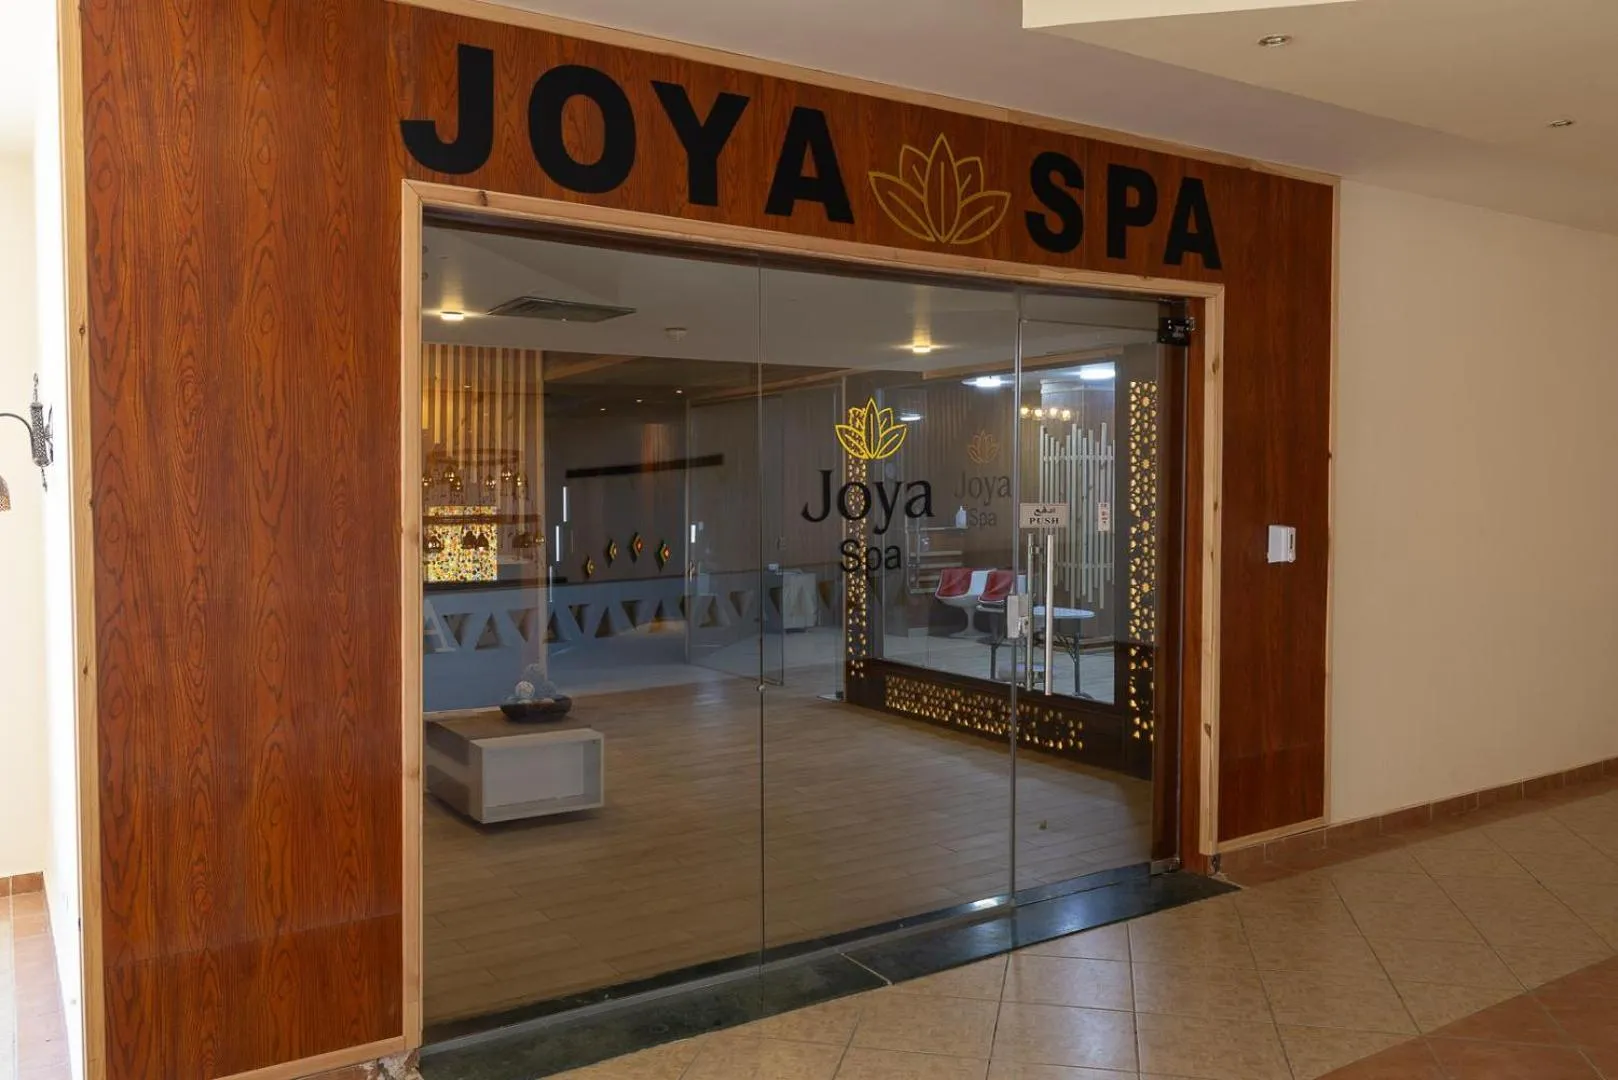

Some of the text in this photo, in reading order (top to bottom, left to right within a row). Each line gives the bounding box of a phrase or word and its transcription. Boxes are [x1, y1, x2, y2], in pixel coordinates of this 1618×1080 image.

[400, 43, 1222, 270] JOYA SPA
[801, 469, 935, 535] Joya
[953, 471, 1012, 506] Joya
[969, 507, 998, 530] Spa
[1029, 517, 1060, 525] PUSH
[840, 538, 902, 578] Spa
